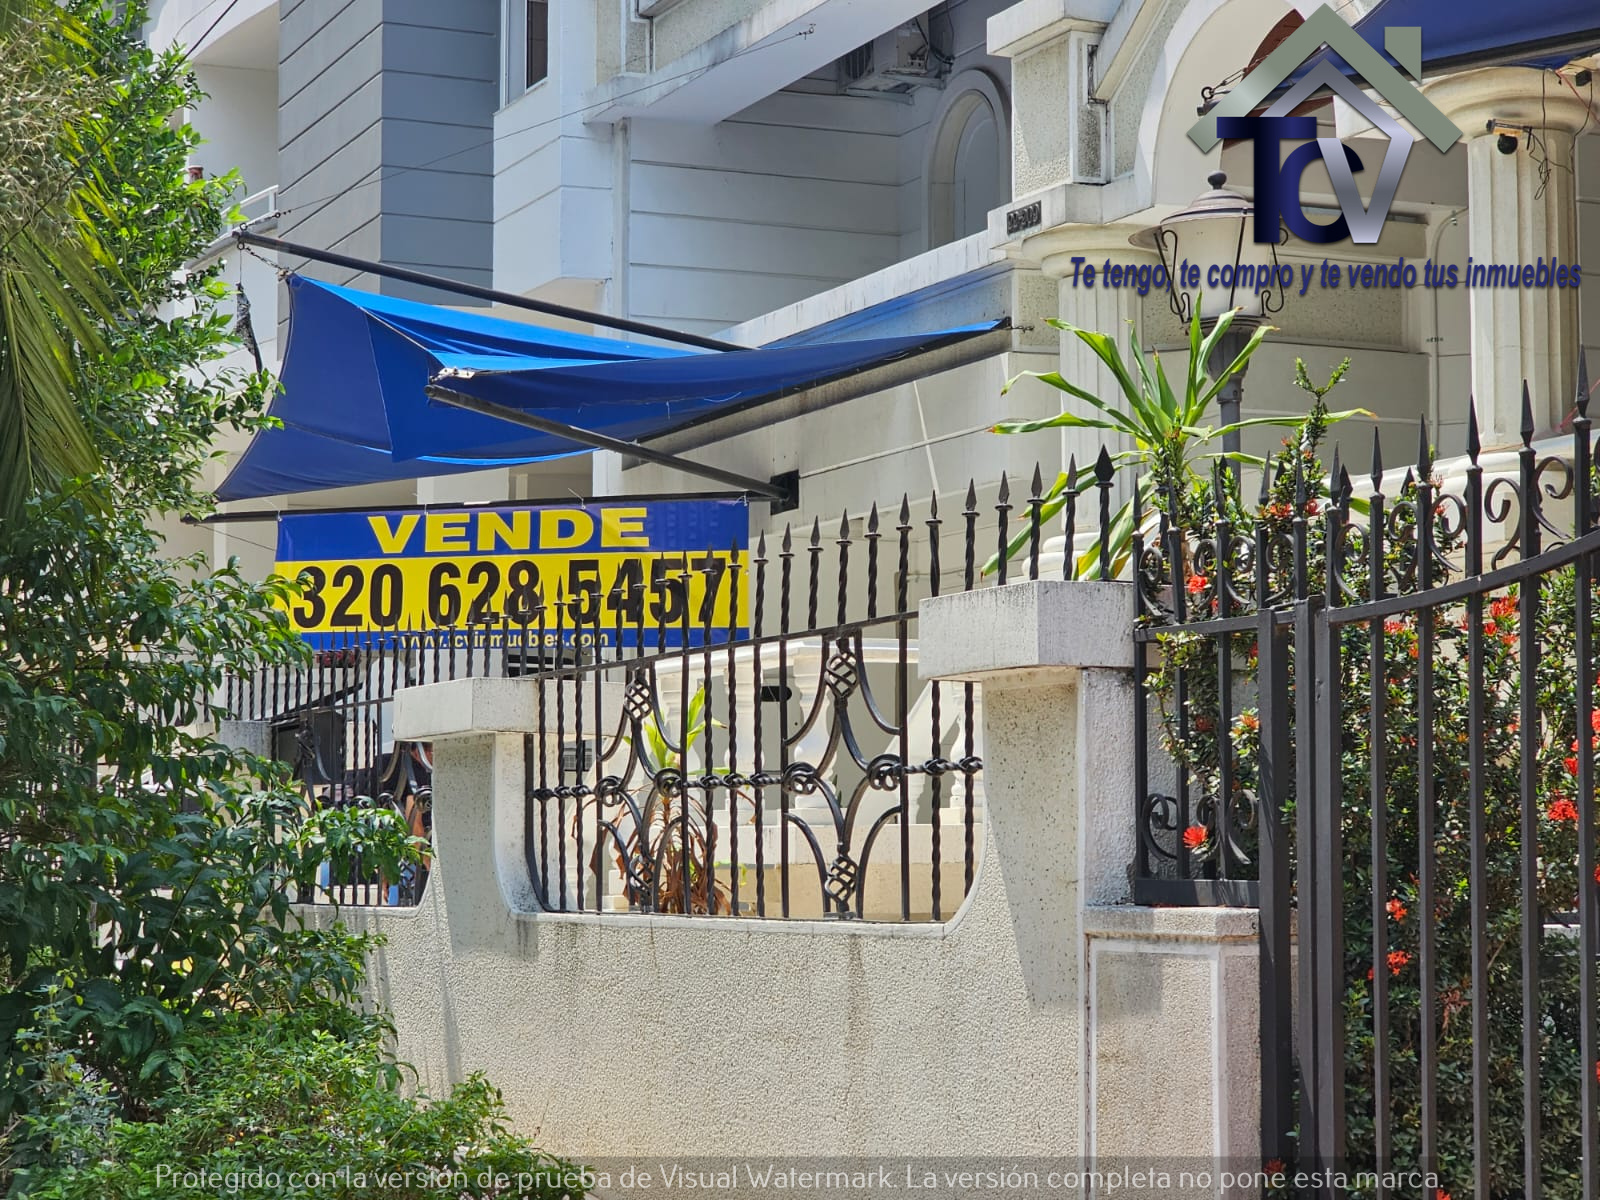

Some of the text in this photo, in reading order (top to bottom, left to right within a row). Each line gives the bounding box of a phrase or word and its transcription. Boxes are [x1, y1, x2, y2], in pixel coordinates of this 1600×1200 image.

[367, 507, 650, 554] VENDE
[293, 558, 726, 628] 320 628 5457
